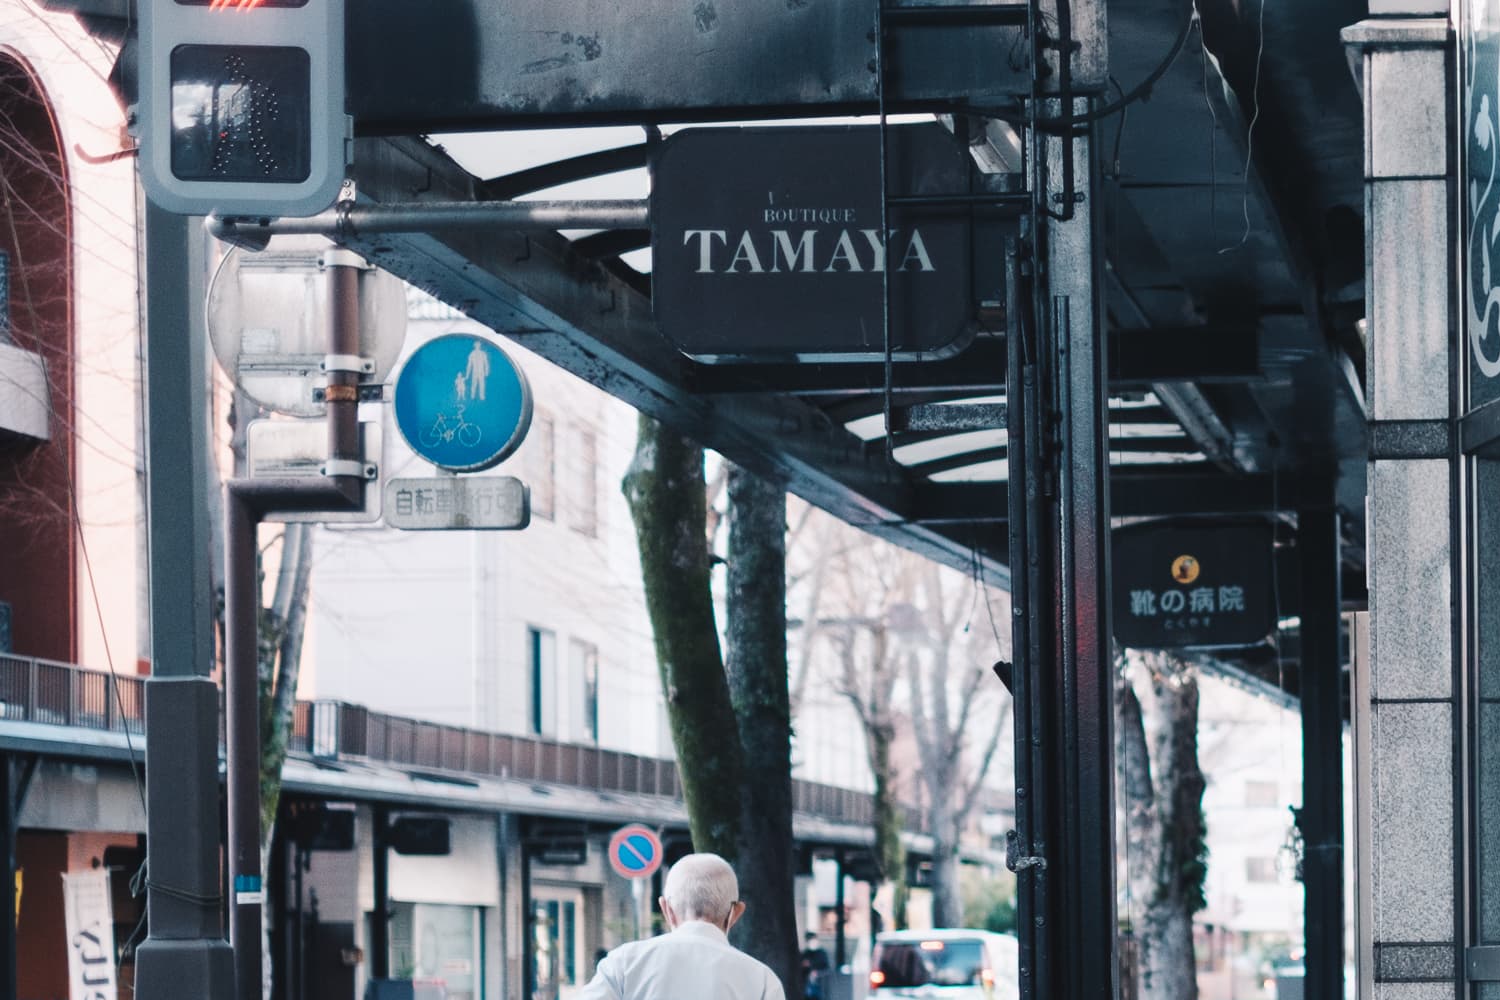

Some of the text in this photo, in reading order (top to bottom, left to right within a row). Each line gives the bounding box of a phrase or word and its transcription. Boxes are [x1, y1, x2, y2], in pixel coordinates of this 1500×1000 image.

[764, 208, 856, 224] BOUTIQUE
[683, 228, 936, 273] TAMAYA
[1130, 586, 1245, 617] 靴の病院
